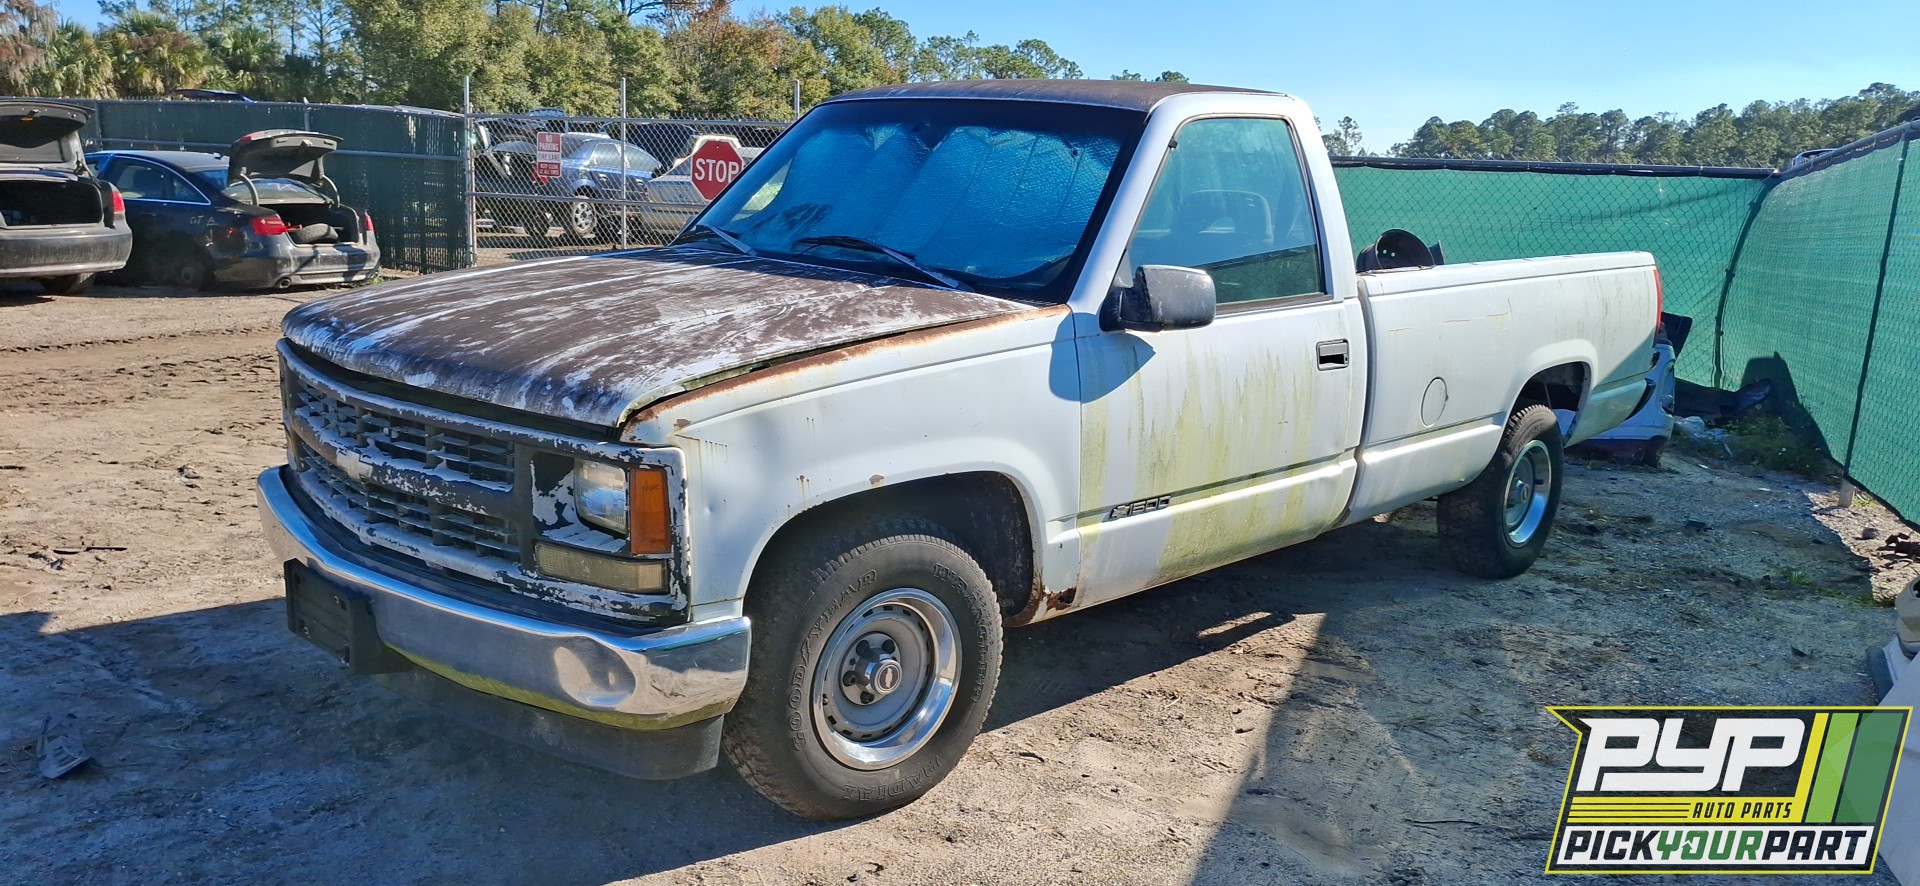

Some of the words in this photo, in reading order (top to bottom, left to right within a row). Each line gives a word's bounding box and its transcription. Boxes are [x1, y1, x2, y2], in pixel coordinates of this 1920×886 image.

[539, 143, 559, 151] PARKING
[545, 134, 553, 143] NO
[694, 158, 740, 183] STOP
[932, 562, 989, 703] WRANGLER
[789, 568, 878, 751] GOODYEAR
[841, 754, 942, 800] RADIAL
